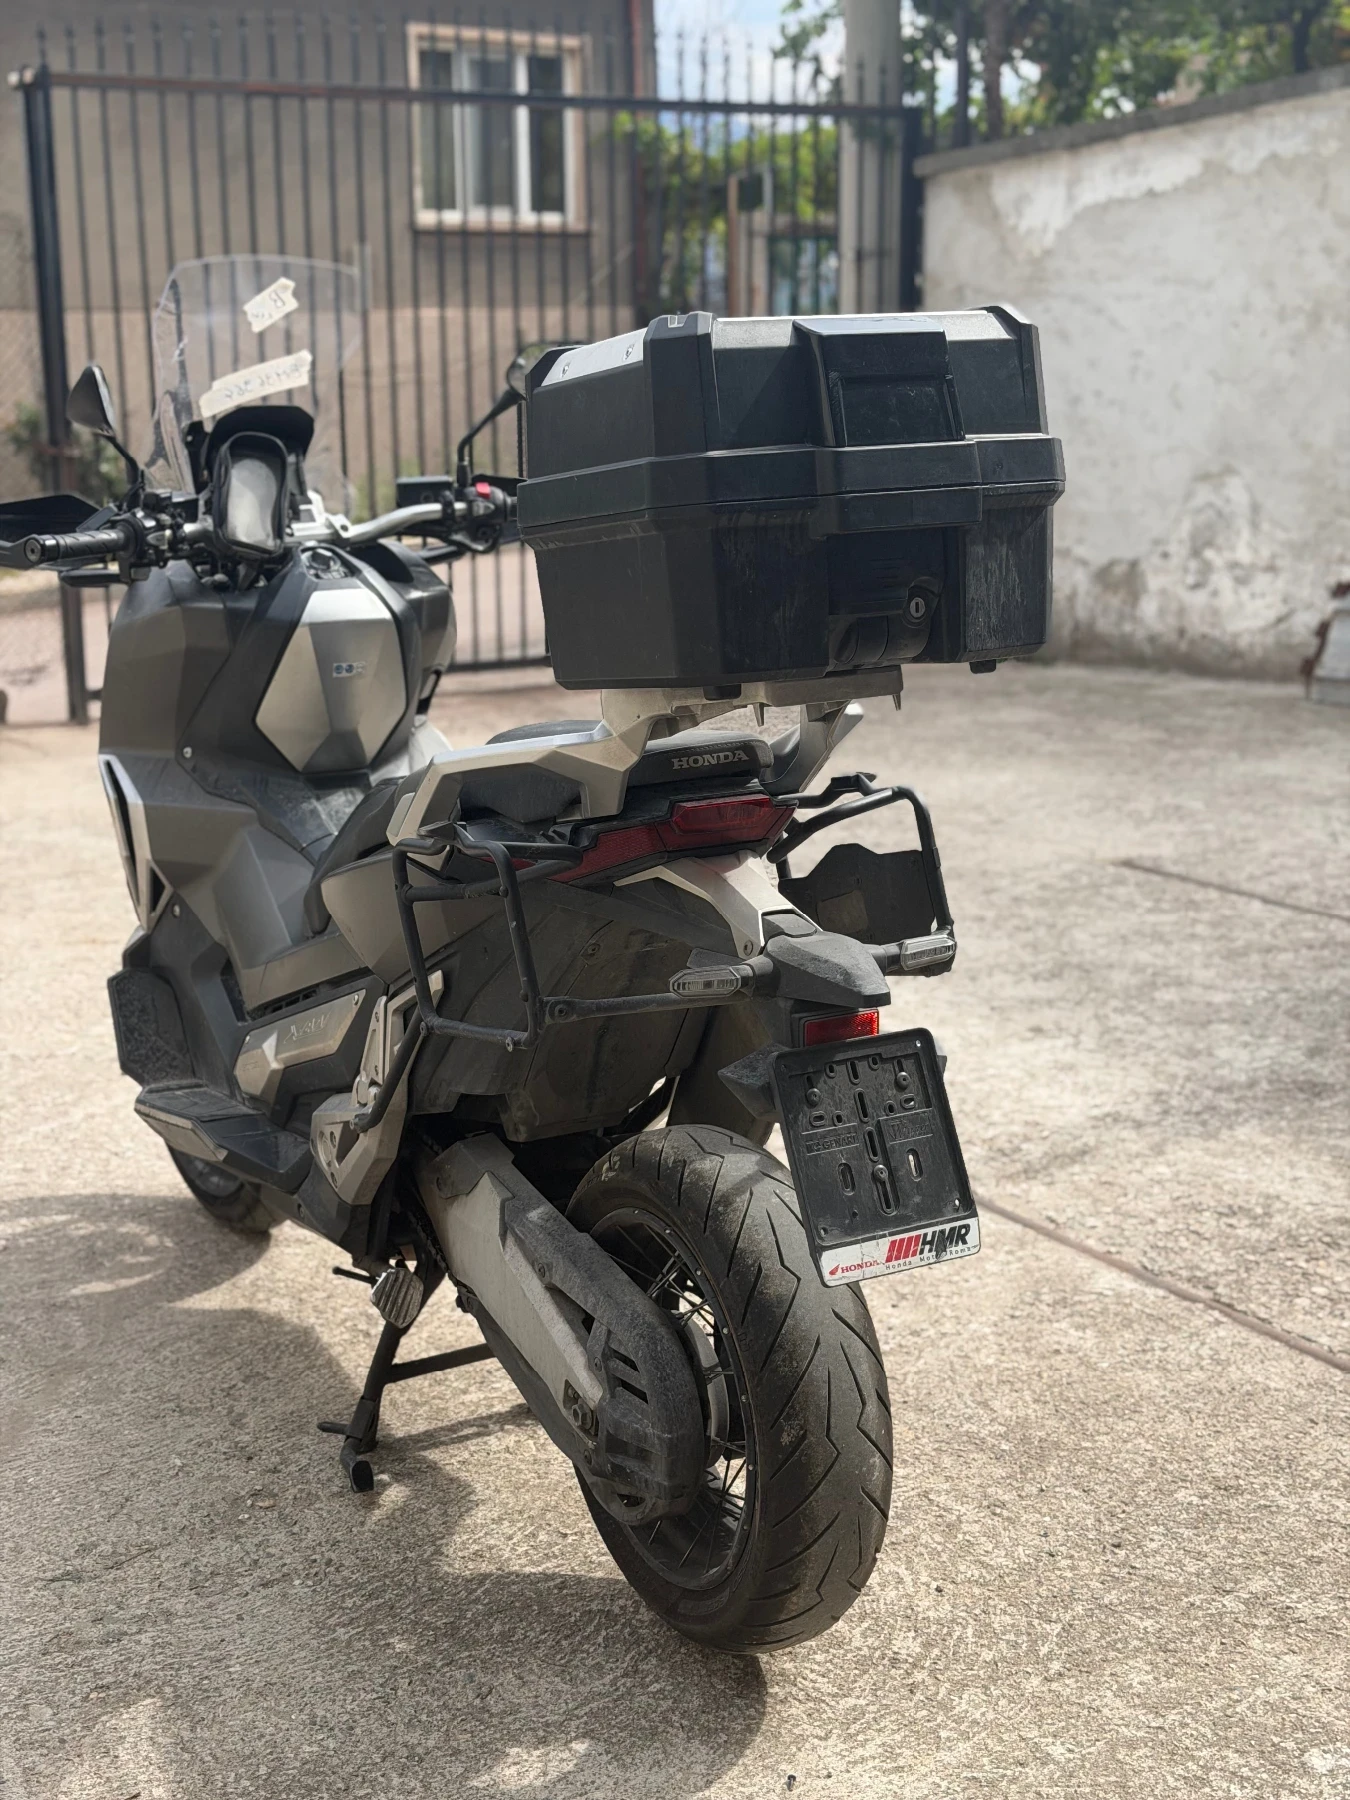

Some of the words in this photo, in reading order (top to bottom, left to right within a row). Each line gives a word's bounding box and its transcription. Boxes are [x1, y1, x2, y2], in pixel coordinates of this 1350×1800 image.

[671, 749, 749, 770] HONDA
[918, 1223, 971, 1256] HMR
[841, 1260, 880, 1273] HONDA
[885, 1260, 913, 1271] Honda
